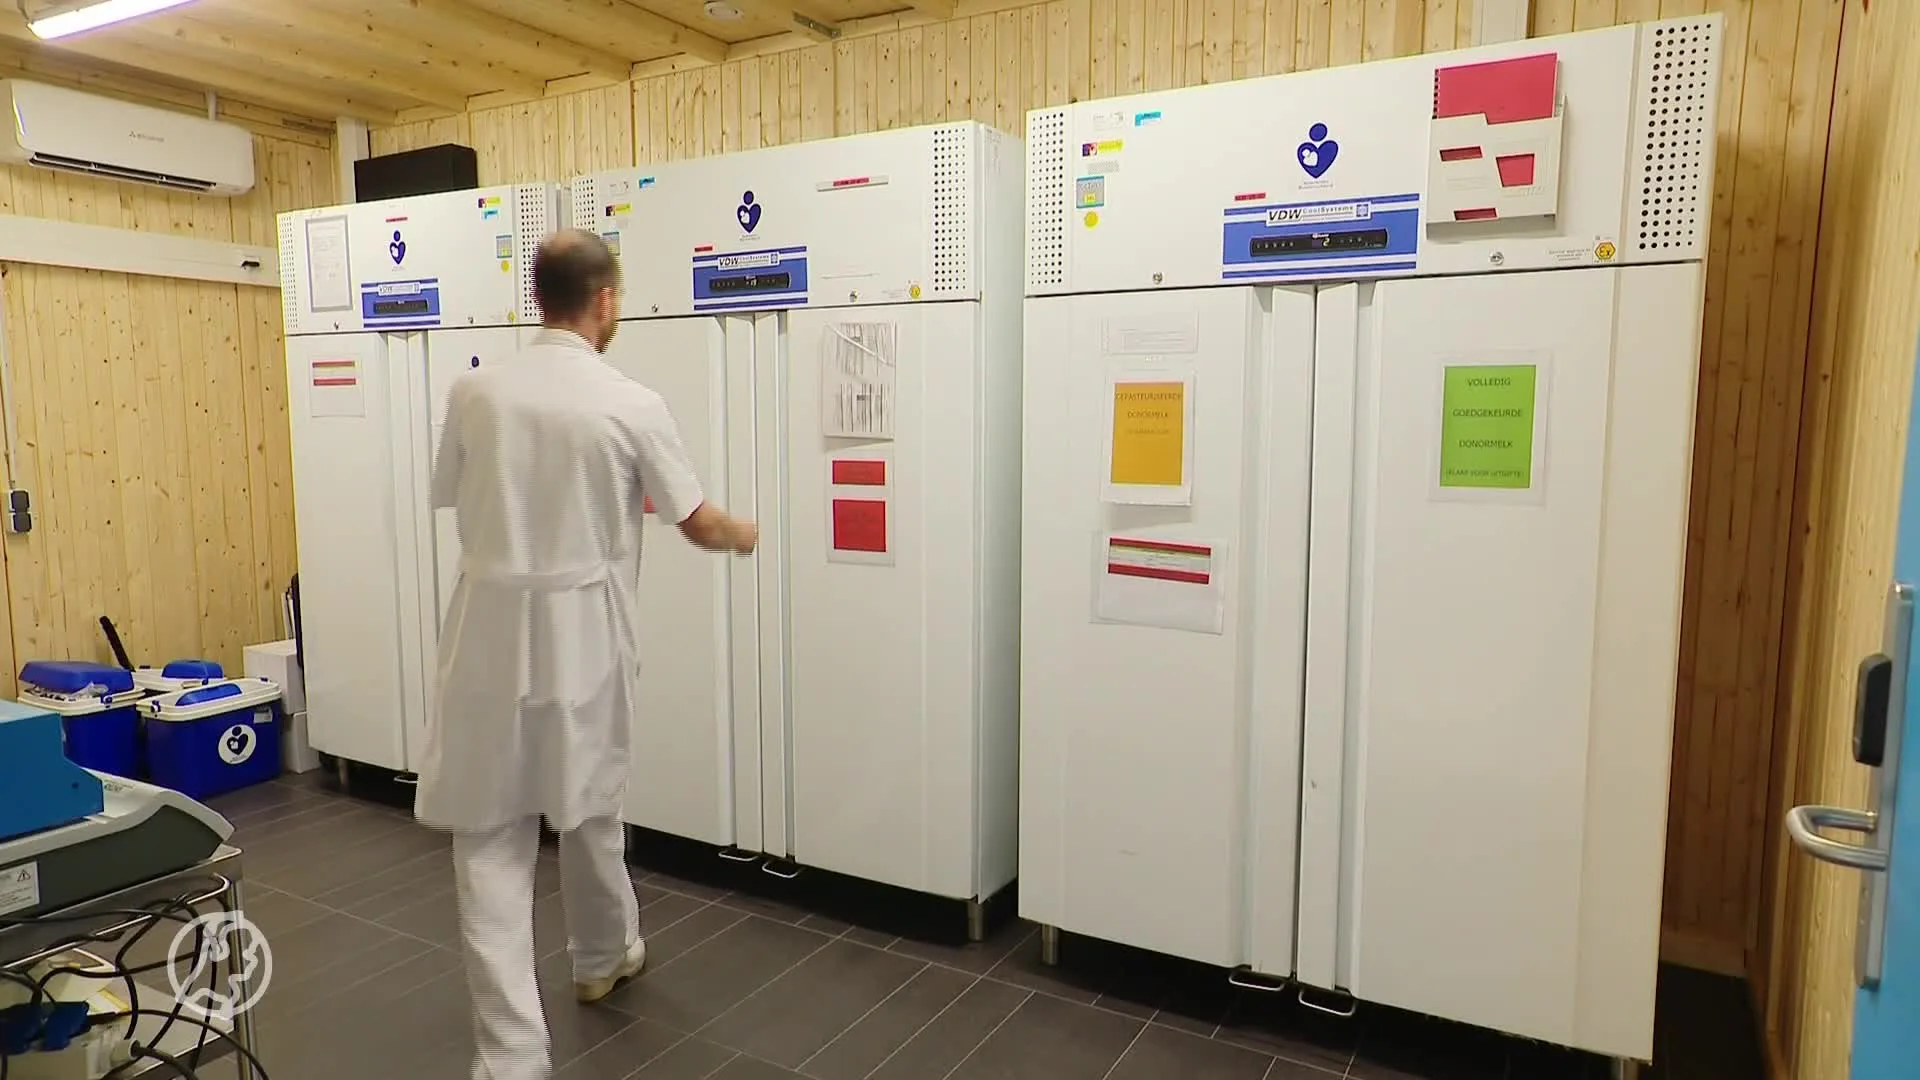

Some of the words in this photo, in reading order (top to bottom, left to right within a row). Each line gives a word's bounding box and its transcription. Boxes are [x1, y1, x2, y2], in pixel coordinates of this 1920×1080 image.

[1269, 208, 1302, 221] VDW
[719, 256, 739, 267] VDW
[1466, 376, 1511, 387] VOLLEDIG
[1452, 407, 1523, 418] GOEDGEKEURDE
[1458, 438, 1513, 449] DONORMELK
